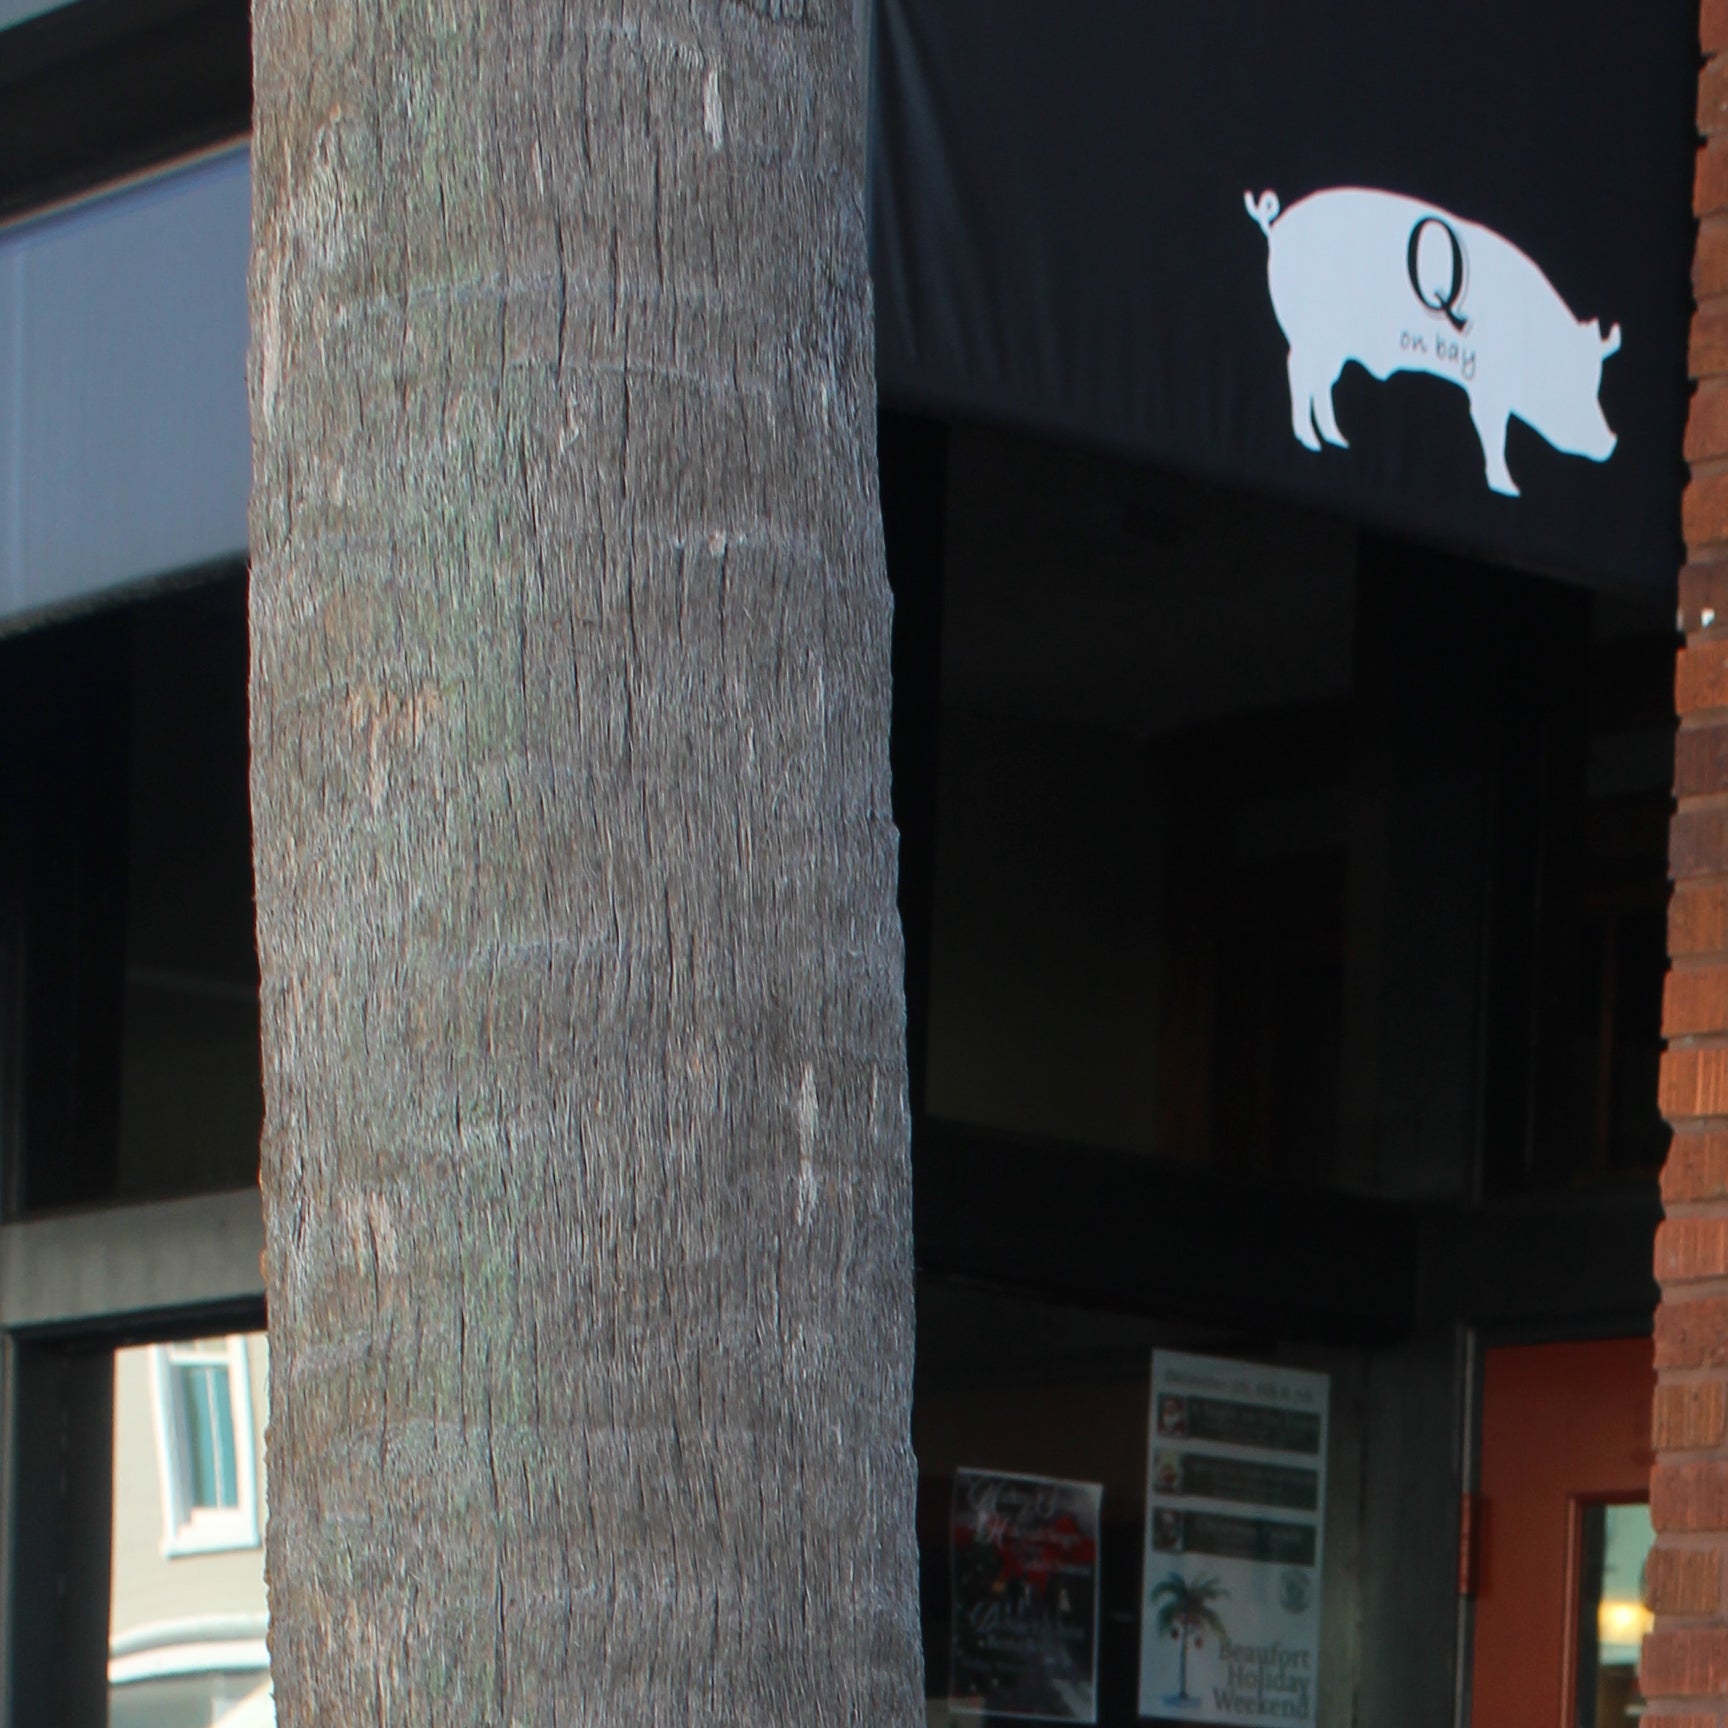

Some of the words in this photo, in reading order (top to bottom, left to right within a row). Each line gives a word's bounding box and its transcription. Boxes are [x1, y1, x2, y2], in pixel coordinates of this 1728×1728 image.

[1406, 216, 1469, 333] Q
[1400, 332, 1427, 354] on
[1436, 332, 1477, 380] bay
[1212, 1687, 1311, 1719] Weekend
